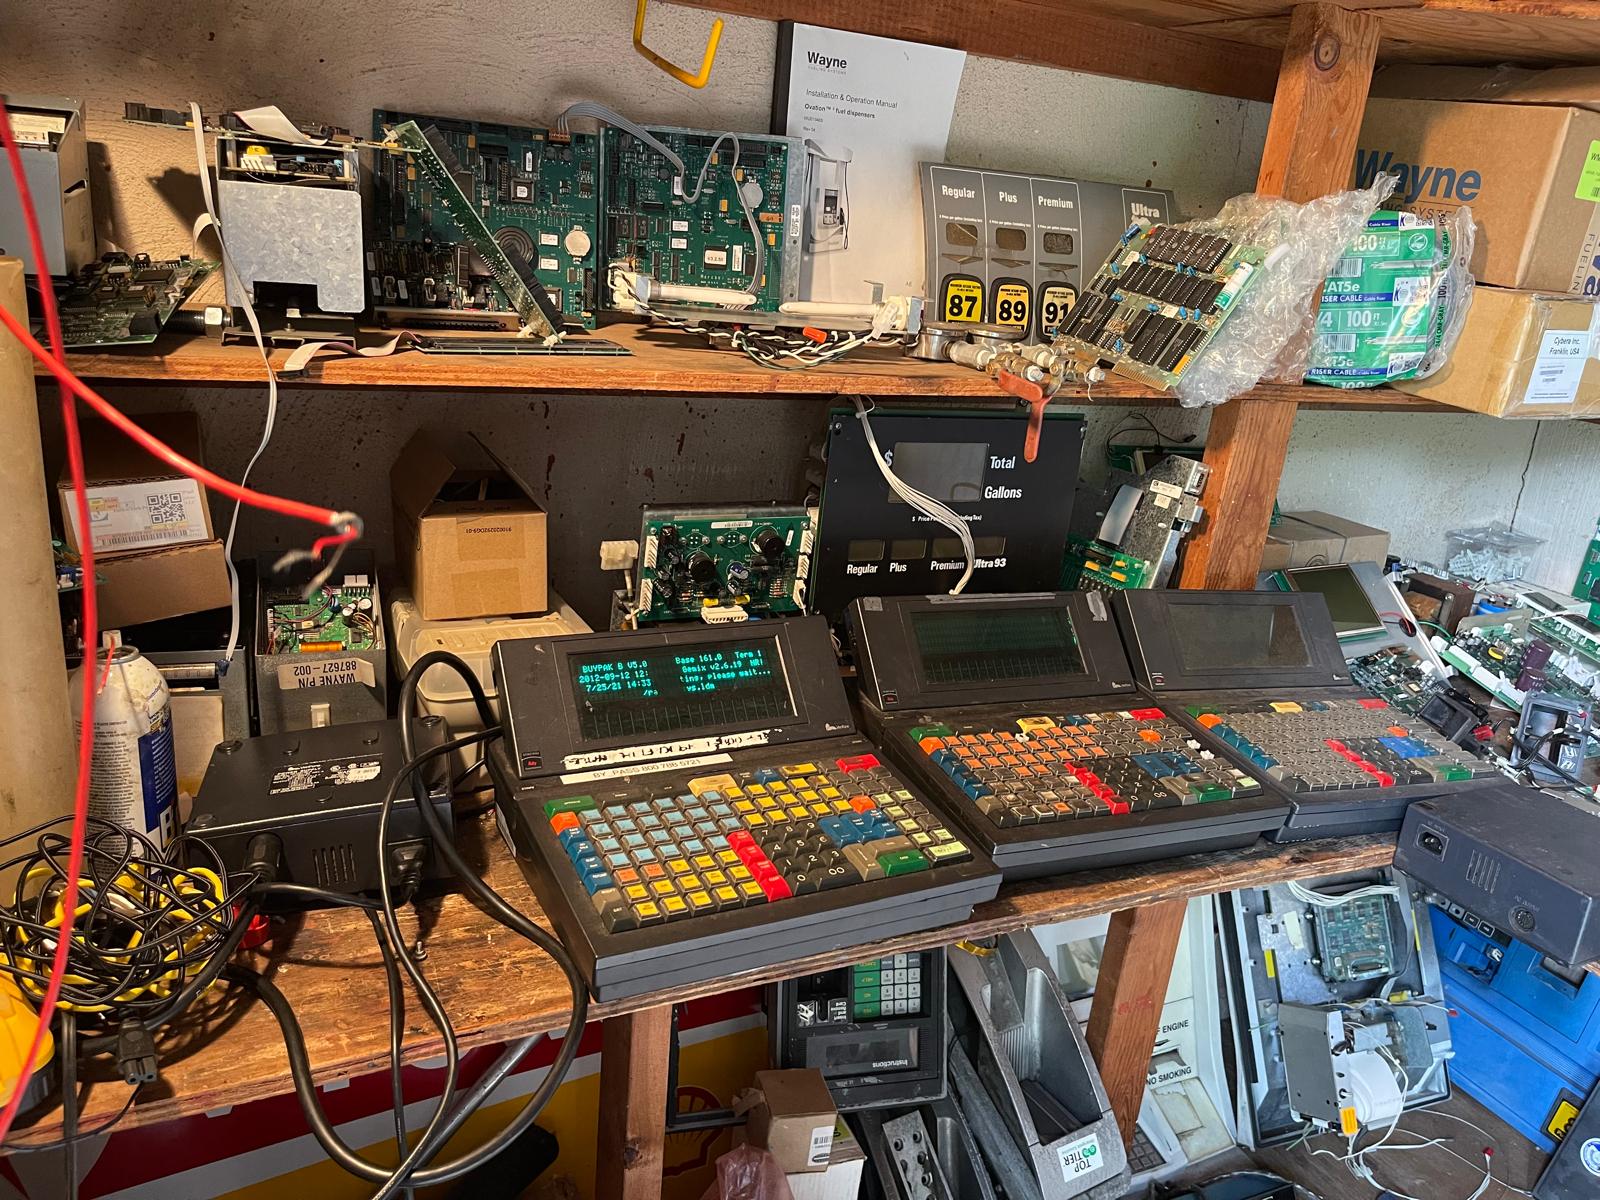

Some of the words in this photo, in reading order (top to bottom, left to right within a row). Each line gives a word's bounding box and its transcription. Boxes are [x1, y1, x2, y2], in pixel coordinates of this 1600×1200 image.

[807, 51, 847, 69] Wayne
[806, 88, 838, 100] Installation
[845, 94, 875, 106] Operation
[876, 99, 898, 109] Manual
[835, 107, 846, 115] fuel
[847, 109, 875, 119] dispensers
[1355, 149, 1481, 204] Wayne
[941, 185, 975, 199] Regular
[999, 191, 1018, 203] Plus
[1038, 195, 1073, 209] Premium
[1131, 202, 1160, 218] Ultra
[1322, 295, 1339, 303] ISER
[1340, 294, 1362, 302] CABLE
[1437, 285, 1447, 299] 100
[949, 294, 977, 317] 87
[999, 299, 1026, 322] 89
[1045, 302, 1069, 323] 91
[1347, 310, 1372, 327] 100
[1373, 312, 1380, 320] FT
[1553, 336, 1570, 346] Cybera
[1568, 347, 1580, 356] USA
[884, 449, 893, 467] $
[990, 456, 1016, 469] Total
[984, 486, 1022, 499] Gallons
[846, 564, 878, 576] Regular
[889, 563, 907, 573] Plus
[930, 560, 965, 571] Premium
[994, 558, 1006, 568] 93
[582, 664, 613, 673] BUYPAK
[618, 662, 624, 670] B
[627, 660, 648, 669] V5.0
[675, 656, 695, 665] Base
[699, 653, 723, 663] 161.0
[734, 651, 753, 659] Term
[757, 649, 762, 657] 1
[579, 672, 630, 684] 2012-09-12
[635, 670, 649, 678] 12:
[710, 660, 742, 671] v2.6.19
[298, 676, 316, 688] P/N
[319, 673, 356, 686] WAYNE
[585, 681, 622, 692] 7/25/21
[627, 678, 651, 688] 14:33
[707, 672, 736, 680] please
[738, 668, 771, 677] wait...
[641, 764, 659, 773] 800
[680, 759, 701, 768] 5721
[773, 843, 781, 851] 4
[808, 854, 817, 862] 2
[828, 866, 845, 875] 00
[1162, 1019, 1189, 1033] ENGINE
[872, 1059, 908, 1068] Instructions
[1146, 1077, 1157, 1085] NO
[1158, 1066, 1191, 1083] SMOKING
[1063, 1151, 1083, 1166] TIER
[1074, 1158, 1092, 1173] TOP
